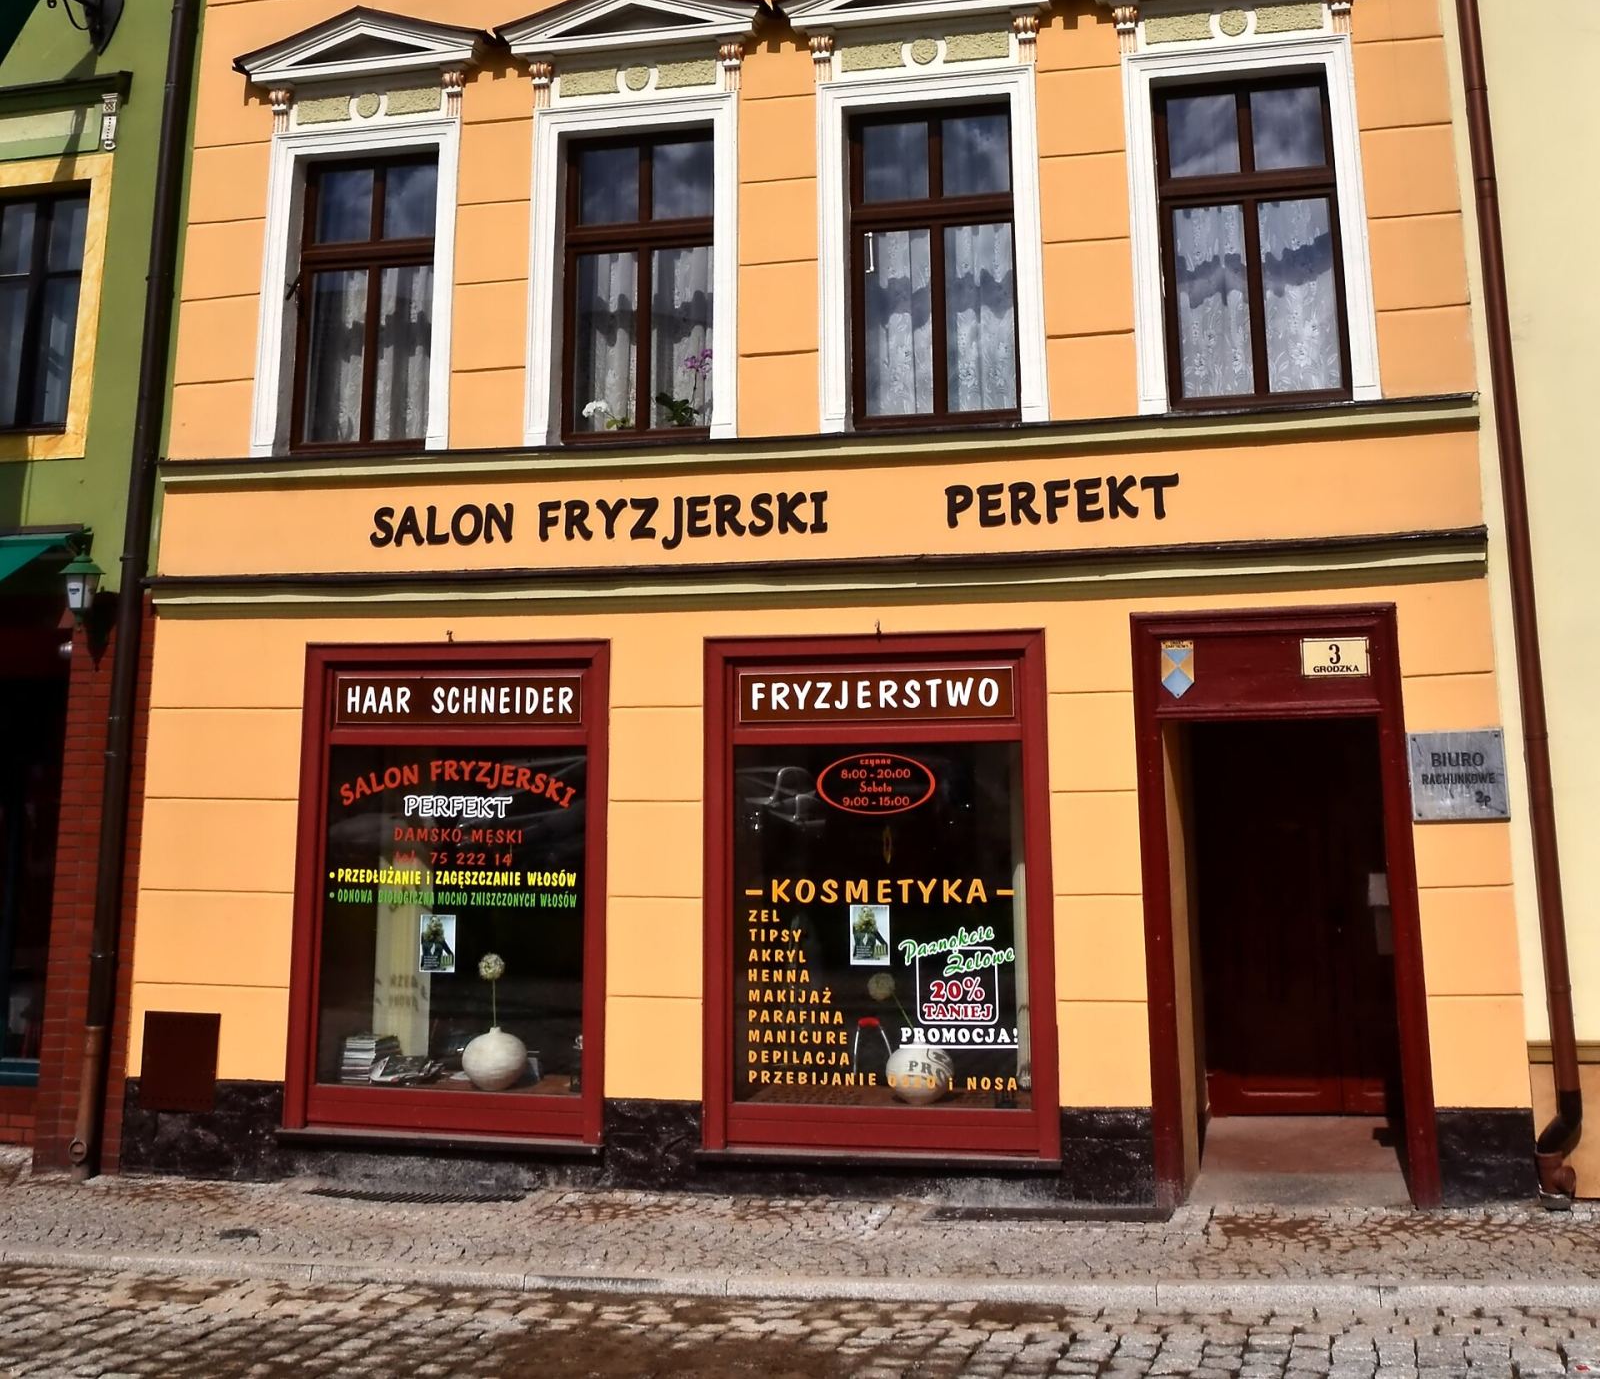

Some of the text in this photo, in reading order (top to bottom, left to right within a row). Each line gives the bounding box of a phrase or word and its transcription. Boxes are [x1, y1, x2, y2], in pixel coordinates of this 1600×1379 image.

[369, 472, 1181, 551] SALON FRYZJERSKI PERFEKT
[1328, 643, 1341, 664] 3
[1312, 664, 1360, 674] GRODZKA
[346, 685, 574, 715] HAAR SCHNEIDER
[751, 677, 999, 711] FRYZJERSTWO
[1431, 752, 1485, 768] BIURO
[340, 760, 576, 808] SALON FRYZJERSKI
[1421, 772, 1497, 785] RACHUNKOWE
[404, 795, 513, 819] PERFEKT
[430, 852, 448, 865] 75
[456, 852, 486, 866] 222
[337, 866, 421, 885] PRZEDŁUŻANIE
[435, 870, 521, 889] ZAGĘSZCZANIE
[527, 869, 577, 887] WŁOSÓW
[337, 888, 373, 904] ODNOWA
[438, 891, 468, 906] MOCNO
[470, 891, 536, 908] ZNISZCZONYCH
[540, 890, 577, 908] WŁOSÓW
[771, 878, 988, 904] KOSMETYKA
[748, 909, 780, 923] ZEL
[749, 928, 802, 943] TIPSY
[898, 926, 995, 965] Paznokcie
[748, 948, 807, 964] AKRYL
[748, 969, 810, 983] HENNA
[748, 987, 832, 1005] MAKIJAŻ
[930, 977, 986, 1002] 20%
[748, 1009, 844, 1025] PARAFINA
[922, 1003, 993, 1020] TANIEJ
[748, 1029, 849, 1045] MANICURE
[900, 1027, 1018, 1043] PROMOCJA!
[748, 1050, 850, 1066] DEPILACJA
[748, 1070, 877, 1087] PRZEBIJANIE
[967, 1077, 1018, 1092] NOSA
